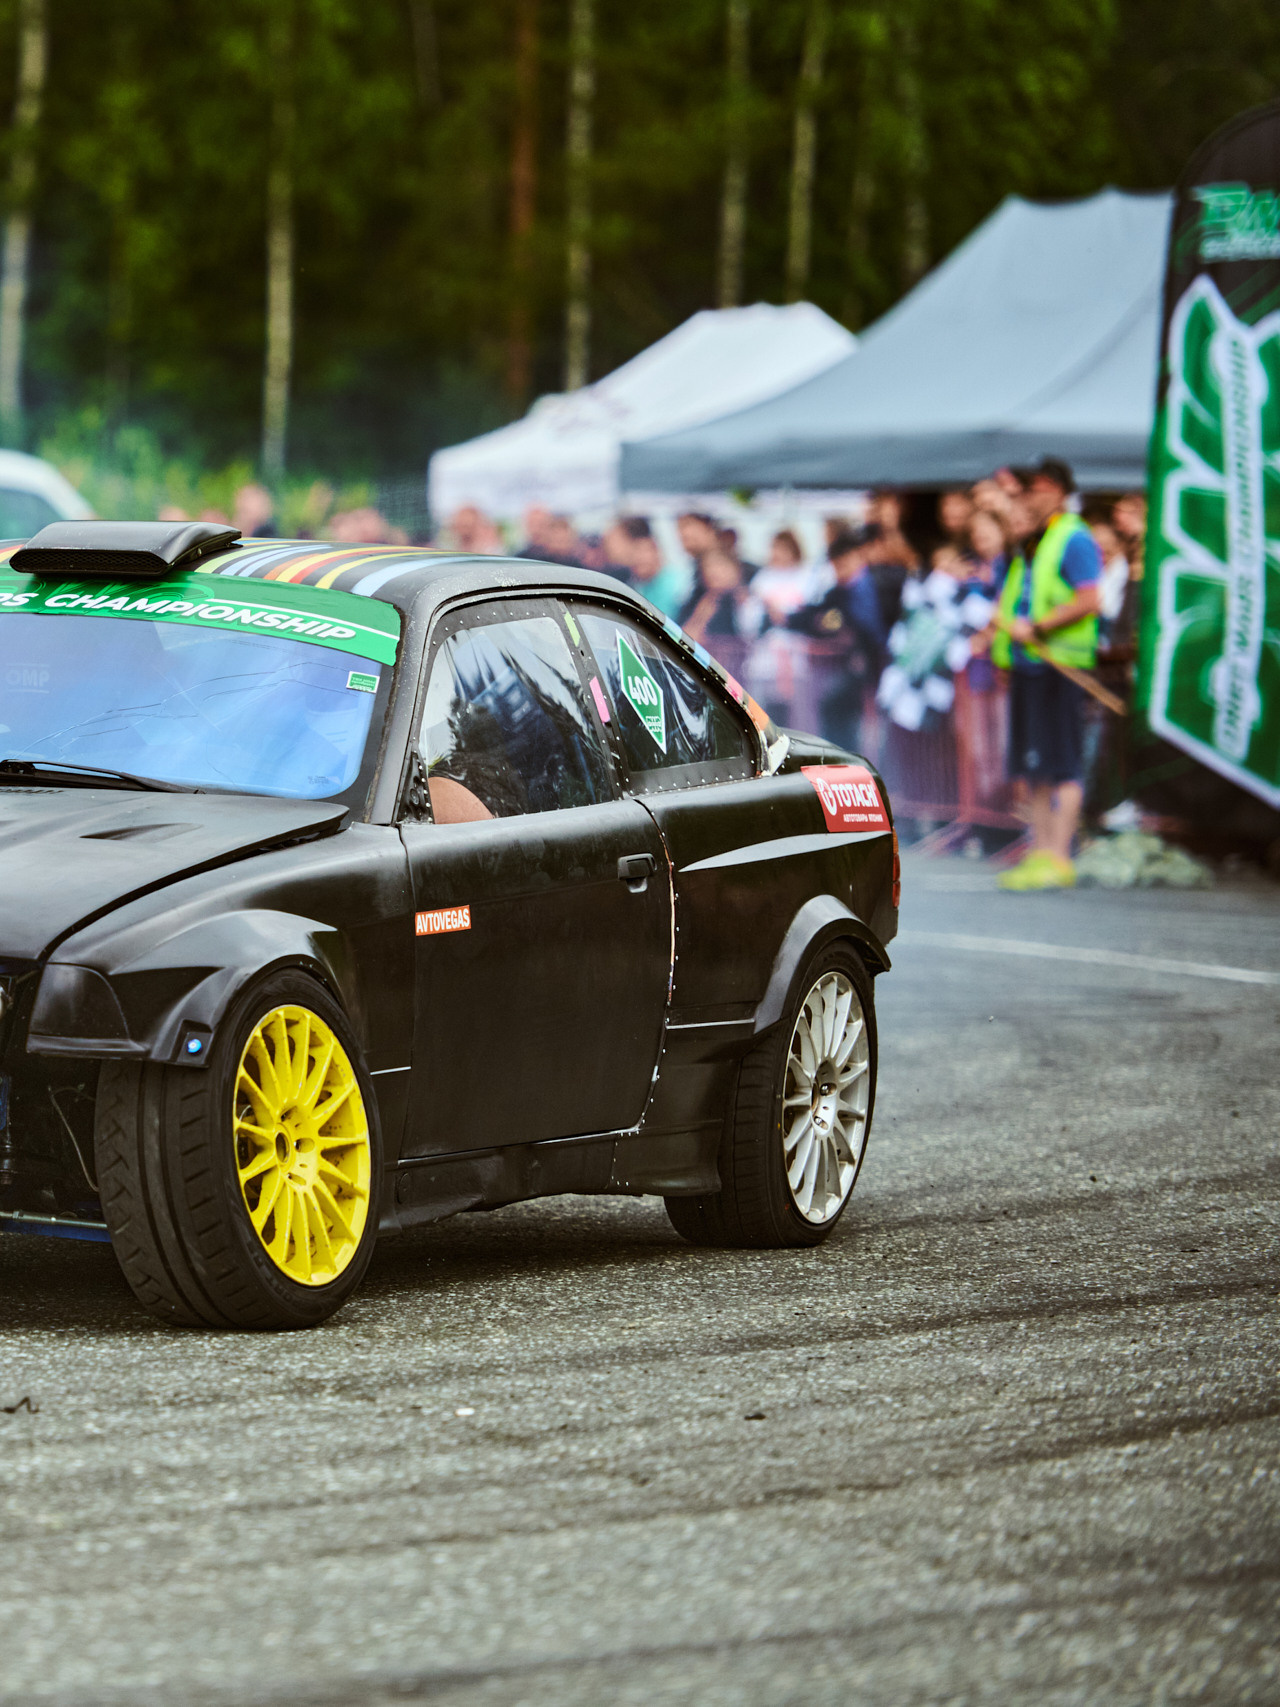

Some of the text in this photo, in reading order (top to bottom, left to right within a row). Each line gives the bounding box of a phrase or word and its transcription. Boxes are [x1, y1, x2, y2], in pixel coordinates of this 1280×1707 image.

[43, 593, 356, 640] CHAMPIONSHIP
[5, 669, 50, 688] OMP
[627, 675, 658, 706] 400
[830, 783, 880, 807] TOTACHI
[416, 908, 470, 934] AVTOVEGAS
